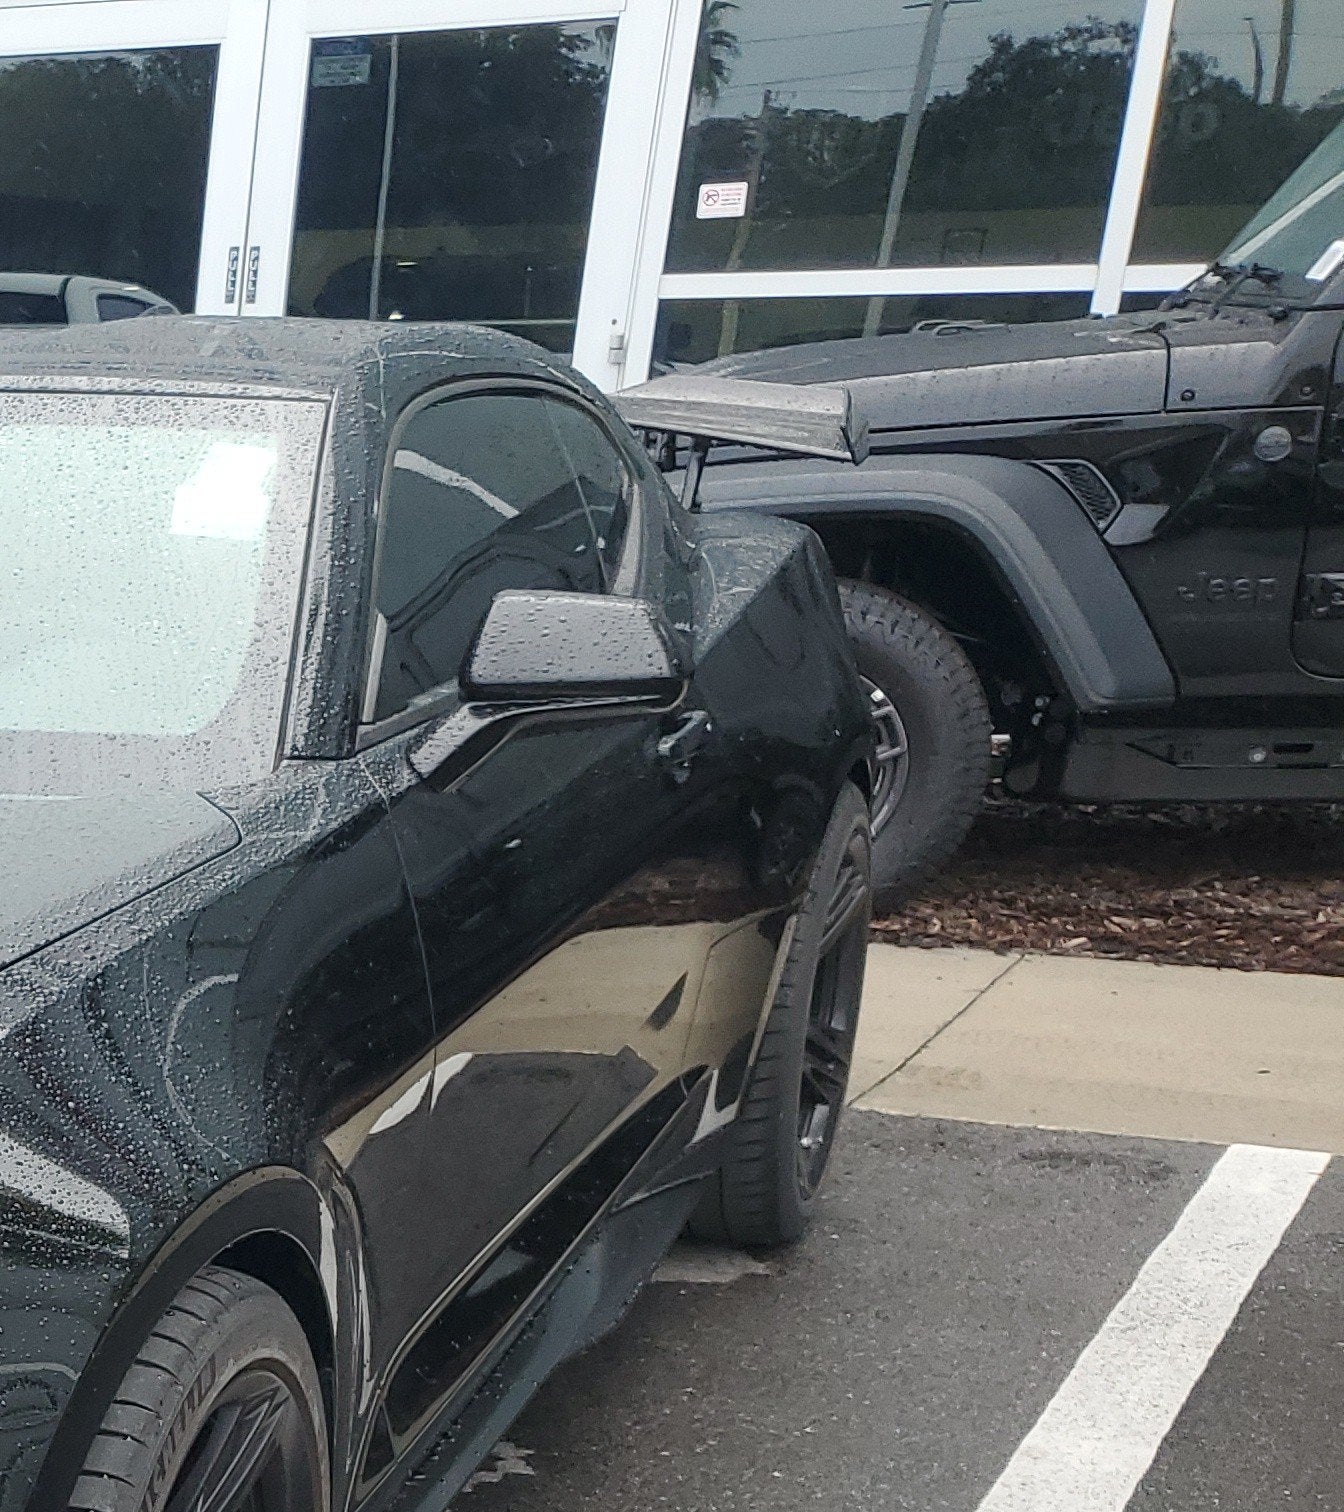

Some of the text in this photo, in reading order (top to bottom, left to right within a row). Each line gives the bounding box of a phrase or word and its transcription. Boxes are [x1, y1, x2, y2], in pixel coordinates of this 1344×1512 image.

[227, 250, 238, 291] PULL
[248, 250, 259, 291] PULL
[1177, 571, 1278, 605] Jeep
